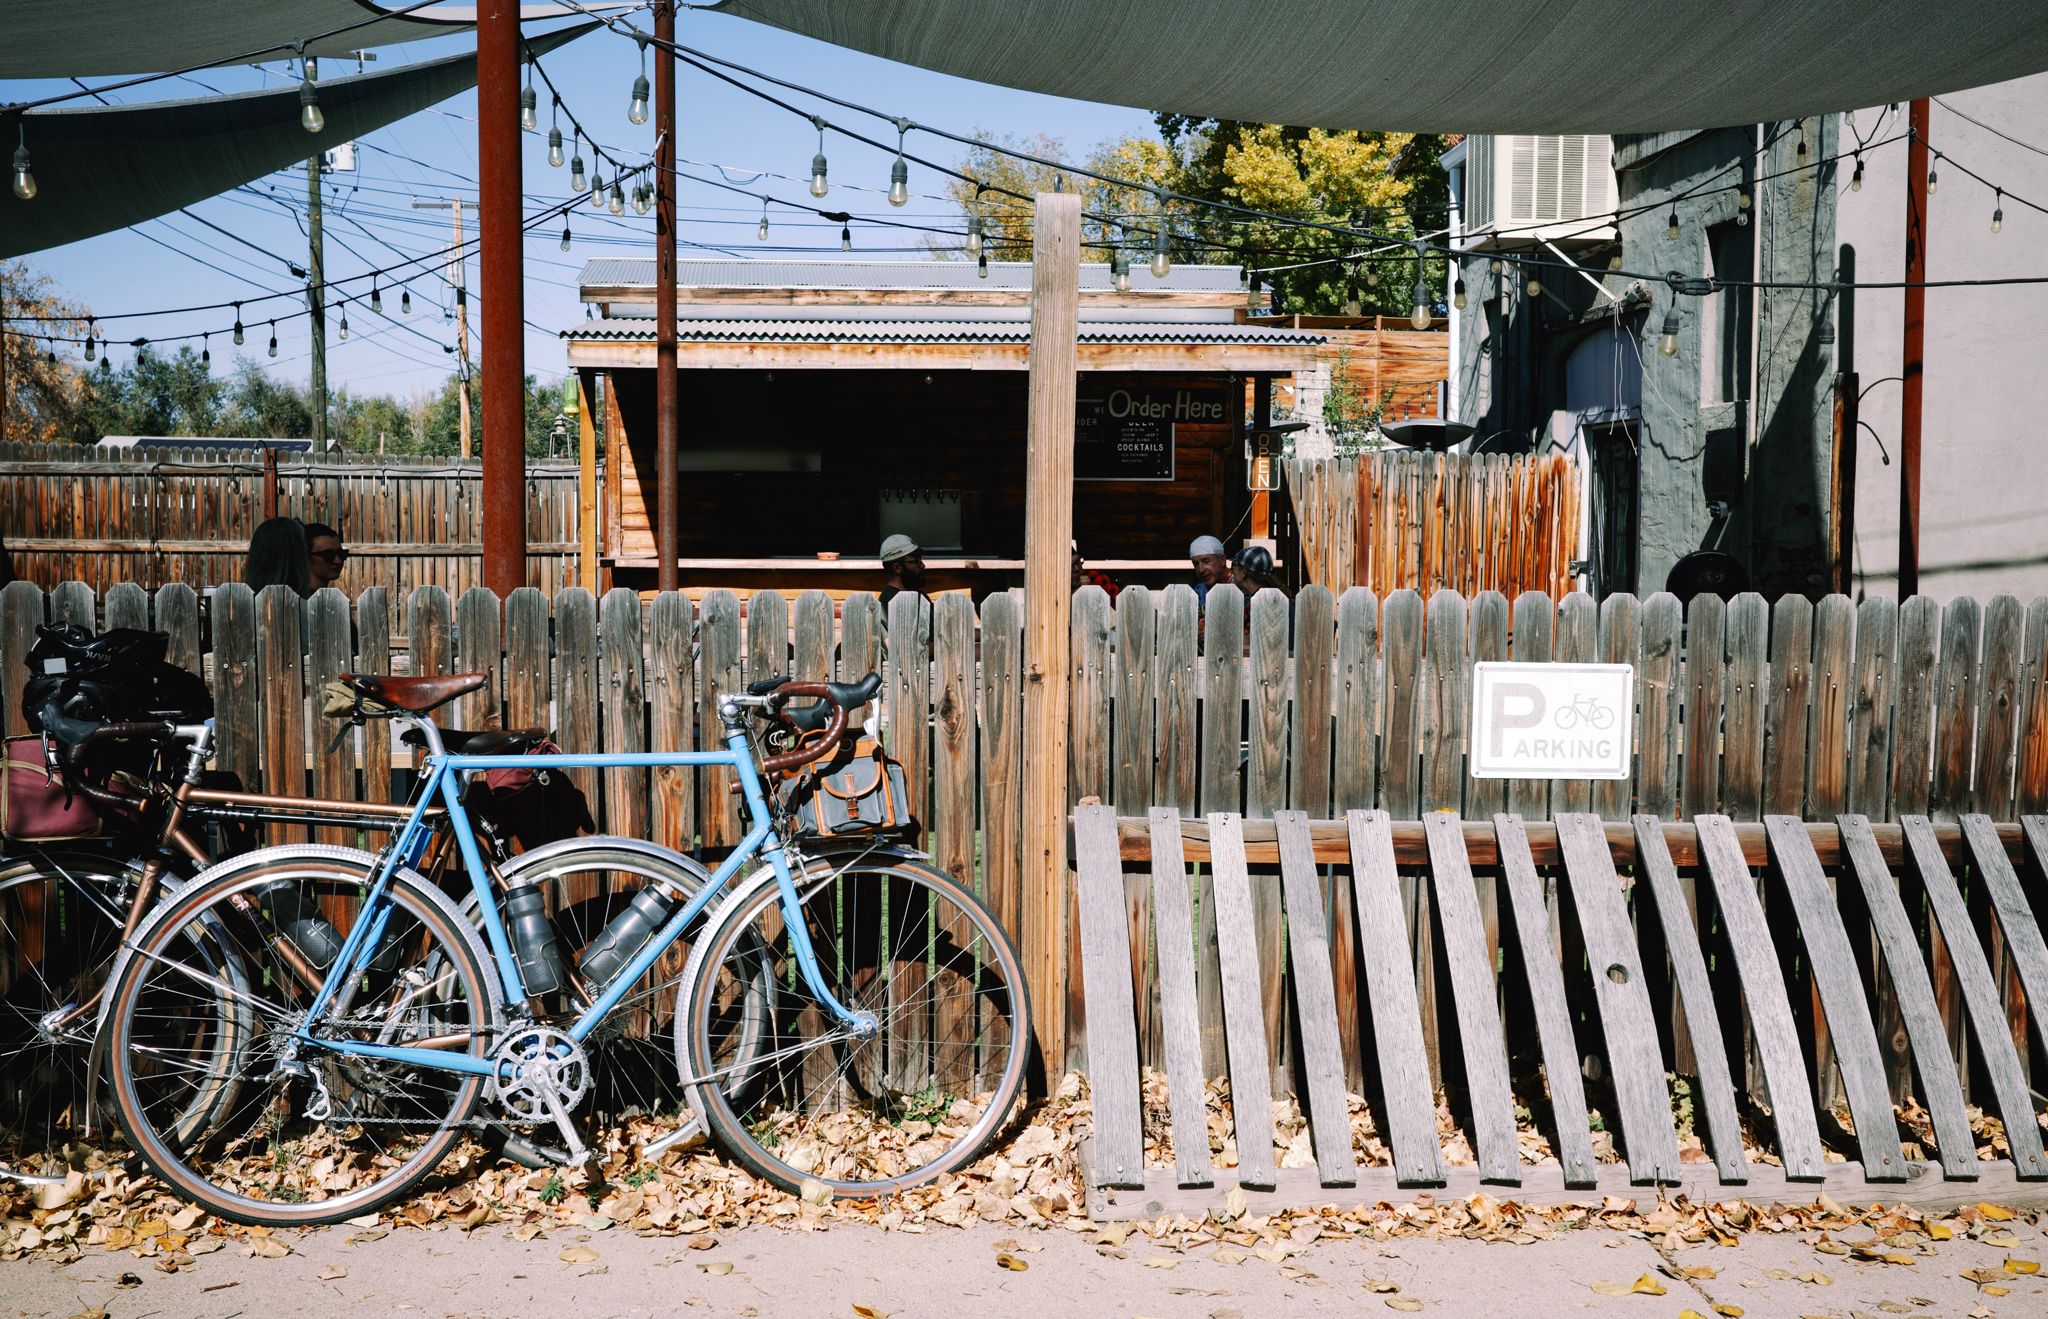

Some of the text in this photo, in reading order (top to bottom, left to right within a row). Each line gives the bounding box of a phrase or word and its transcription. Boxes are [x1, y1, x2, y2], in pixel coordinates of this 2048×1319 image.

[1109, 389, 1222, 420] Order Here
[1117, 443, 1164, 452] COCKTAILS
[1258, 433, 1270, 489] OPEN
[1490, 682, 1612, 759] PARKING
